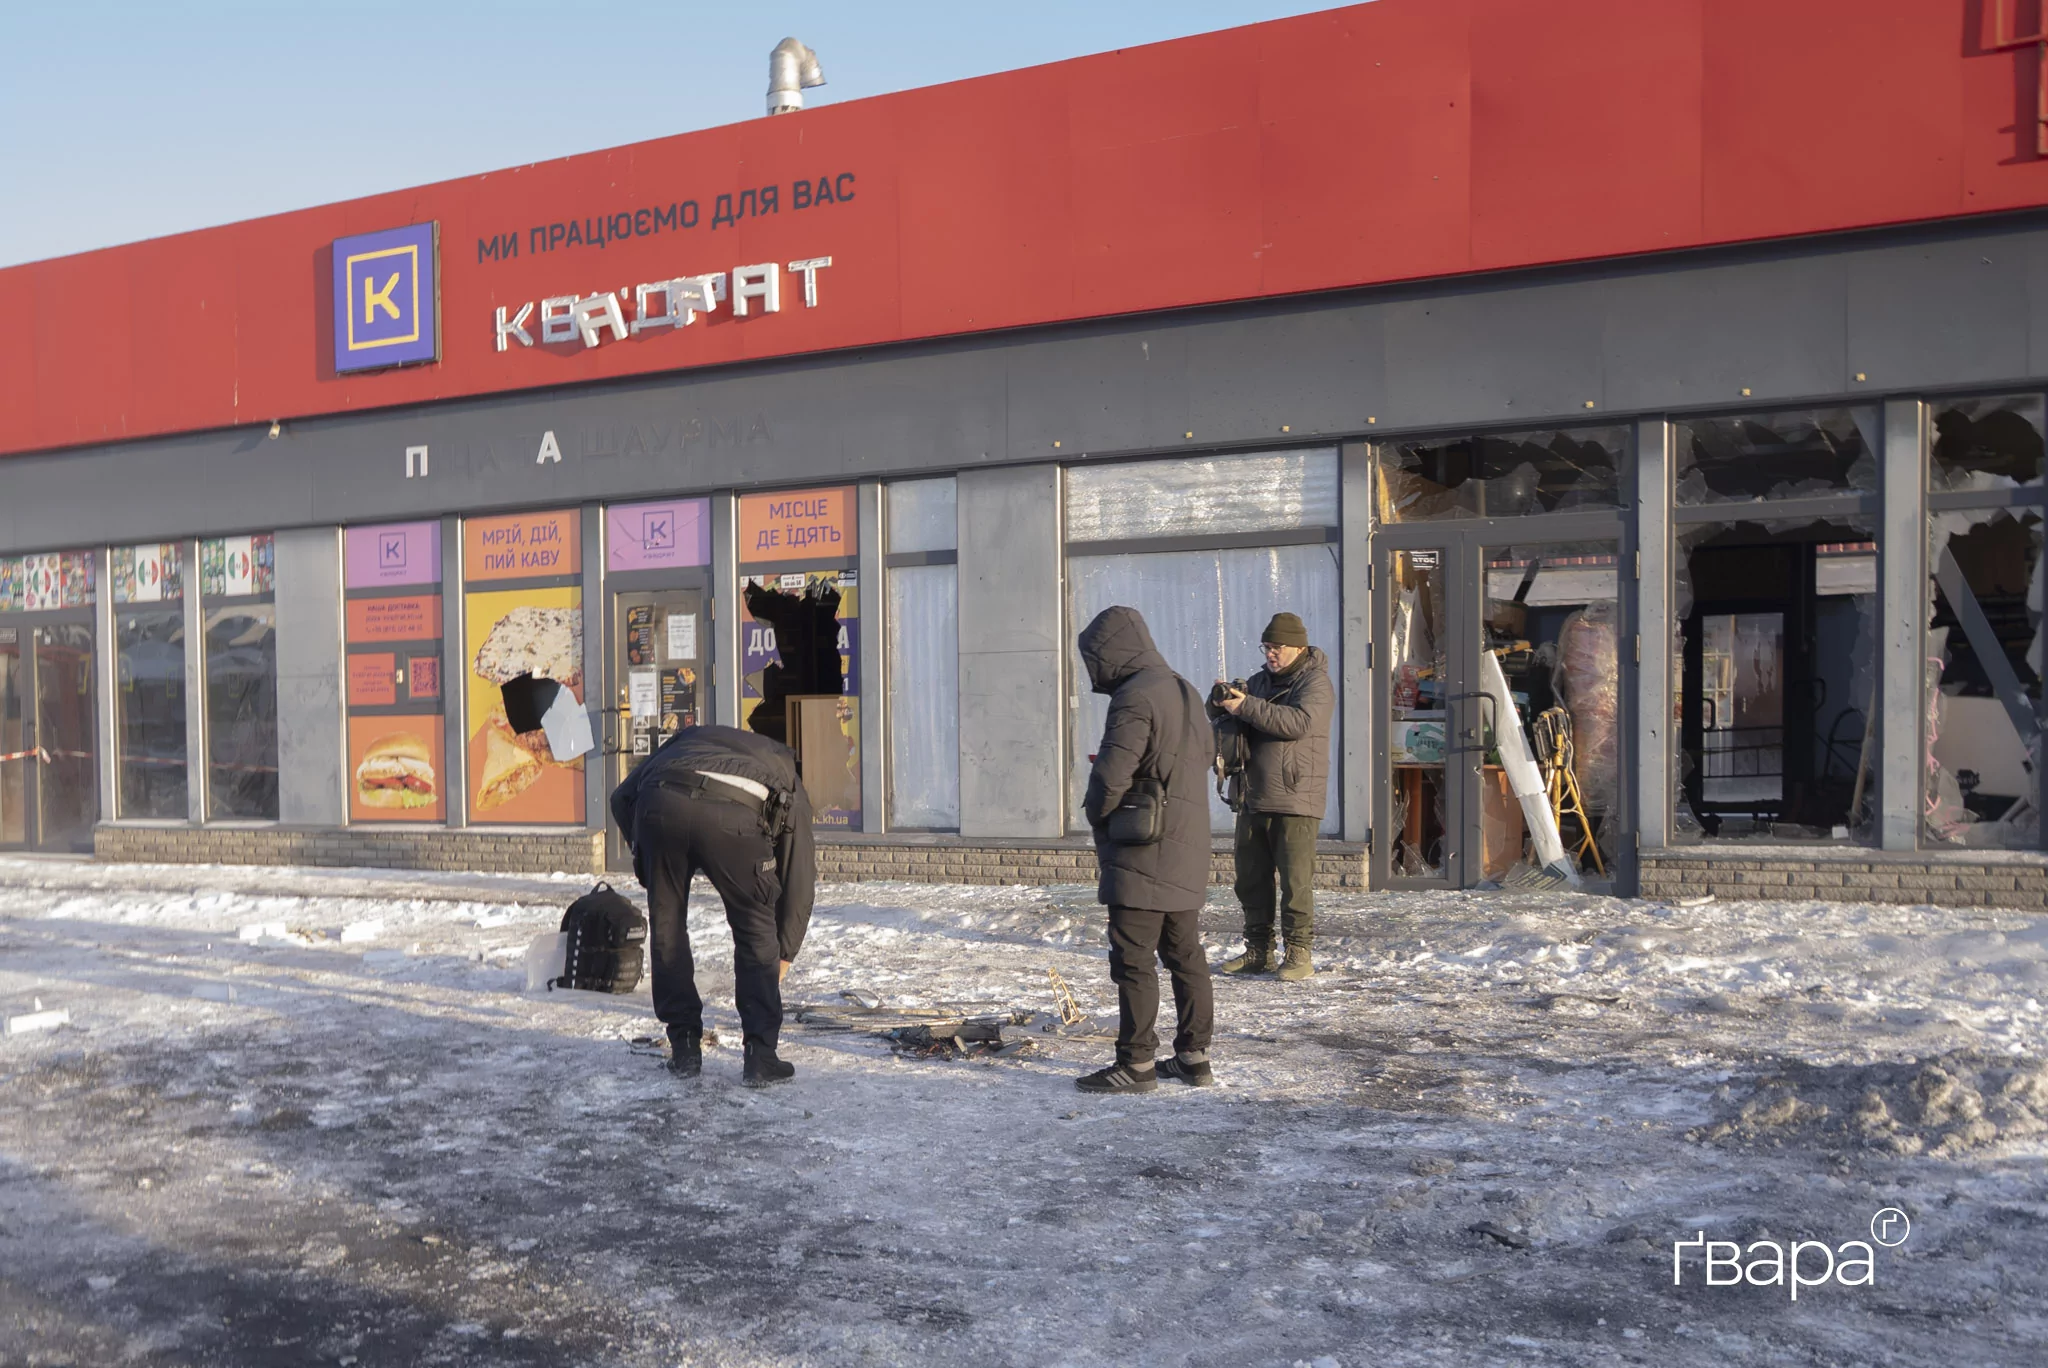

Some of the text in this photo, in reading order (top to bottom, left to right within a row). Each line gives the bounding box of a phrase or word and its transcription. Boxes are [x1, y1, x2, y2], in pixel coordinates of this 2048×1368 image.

[478, 172, 856, 264] МИ ПРАЦЮЄМО ДЛЯ ВАС
[364, 272, 401, 325] К
[769, 499, 828, 520] МІСЦЕ
[482, 520, 562, 546] МРІЙ, ДІЙ,
[756, 523, 842, 550] ДЕ ЇДЯТЬ
[485, 549, 560, 571] ПИЙ КАВУ
